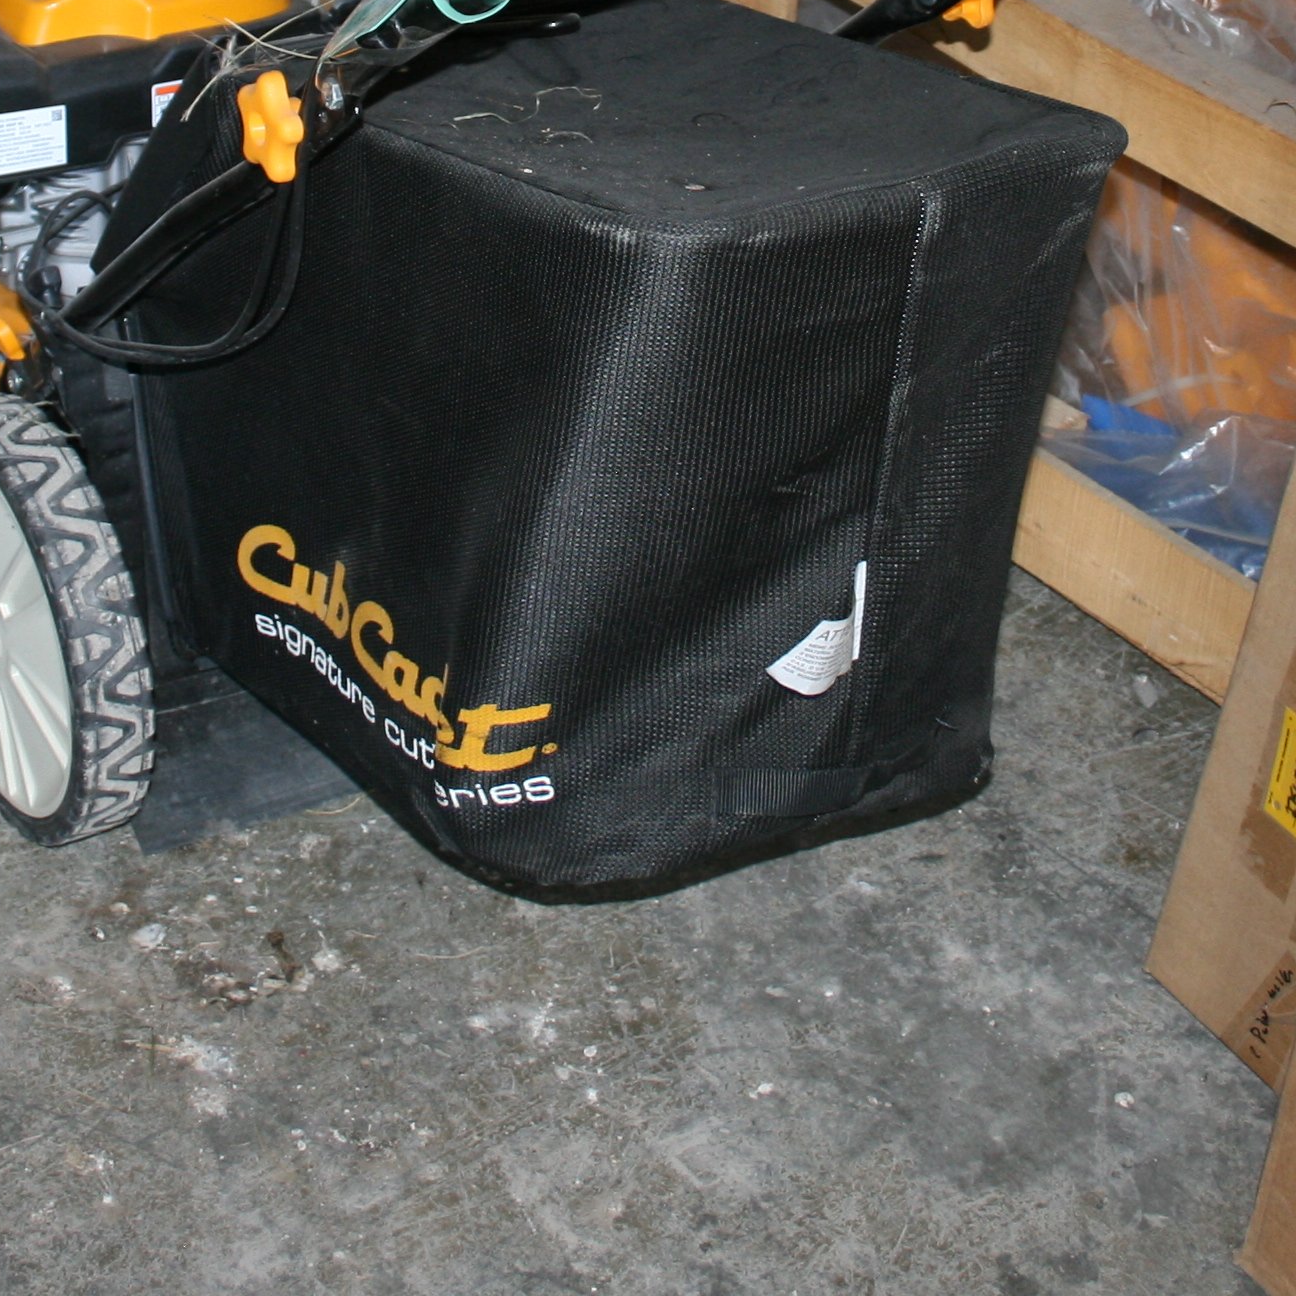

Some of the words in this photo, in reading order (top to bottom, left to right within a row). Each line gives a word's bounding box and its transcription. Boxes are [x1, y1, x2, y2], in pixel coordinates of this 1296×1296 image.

[238, 524, 350, 639] Cub
[255, 613, 376, 724] signature
[384, 719, 437, 770] cut
